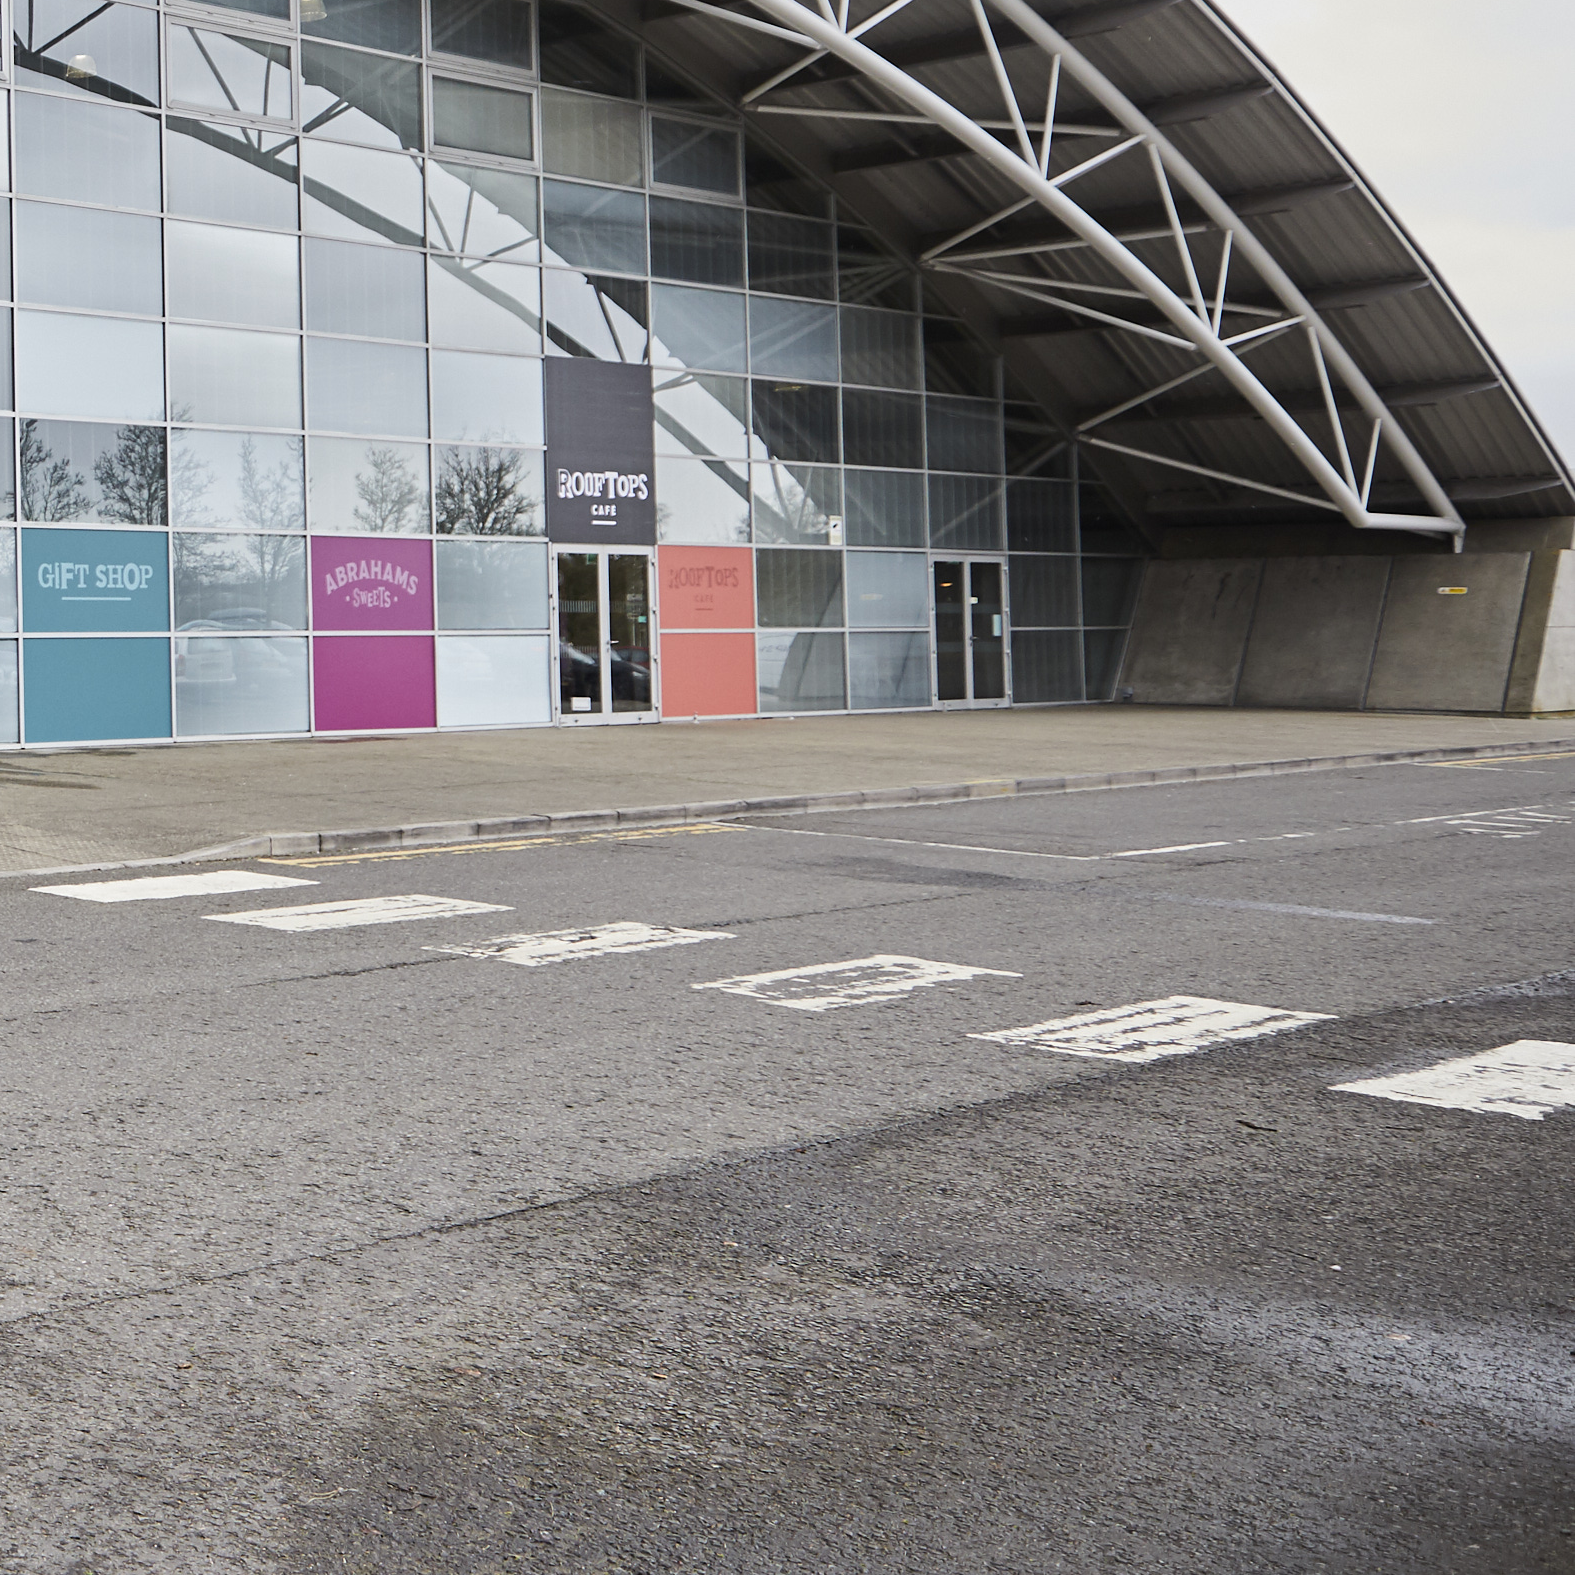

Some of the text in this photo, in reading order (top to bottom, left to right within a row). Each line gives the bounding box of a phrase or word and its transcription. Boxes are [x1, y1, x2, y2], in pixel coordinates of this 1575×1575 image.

[557, 468, 649, 500] ROOFTOPS
[95, 562, 153, 591] SHOP
[325, 560, 418, 595] ABRAHAMS
[668, 566, 739, 589] ROOFTOPS
[353, 586, 391, 608] SWEETS
